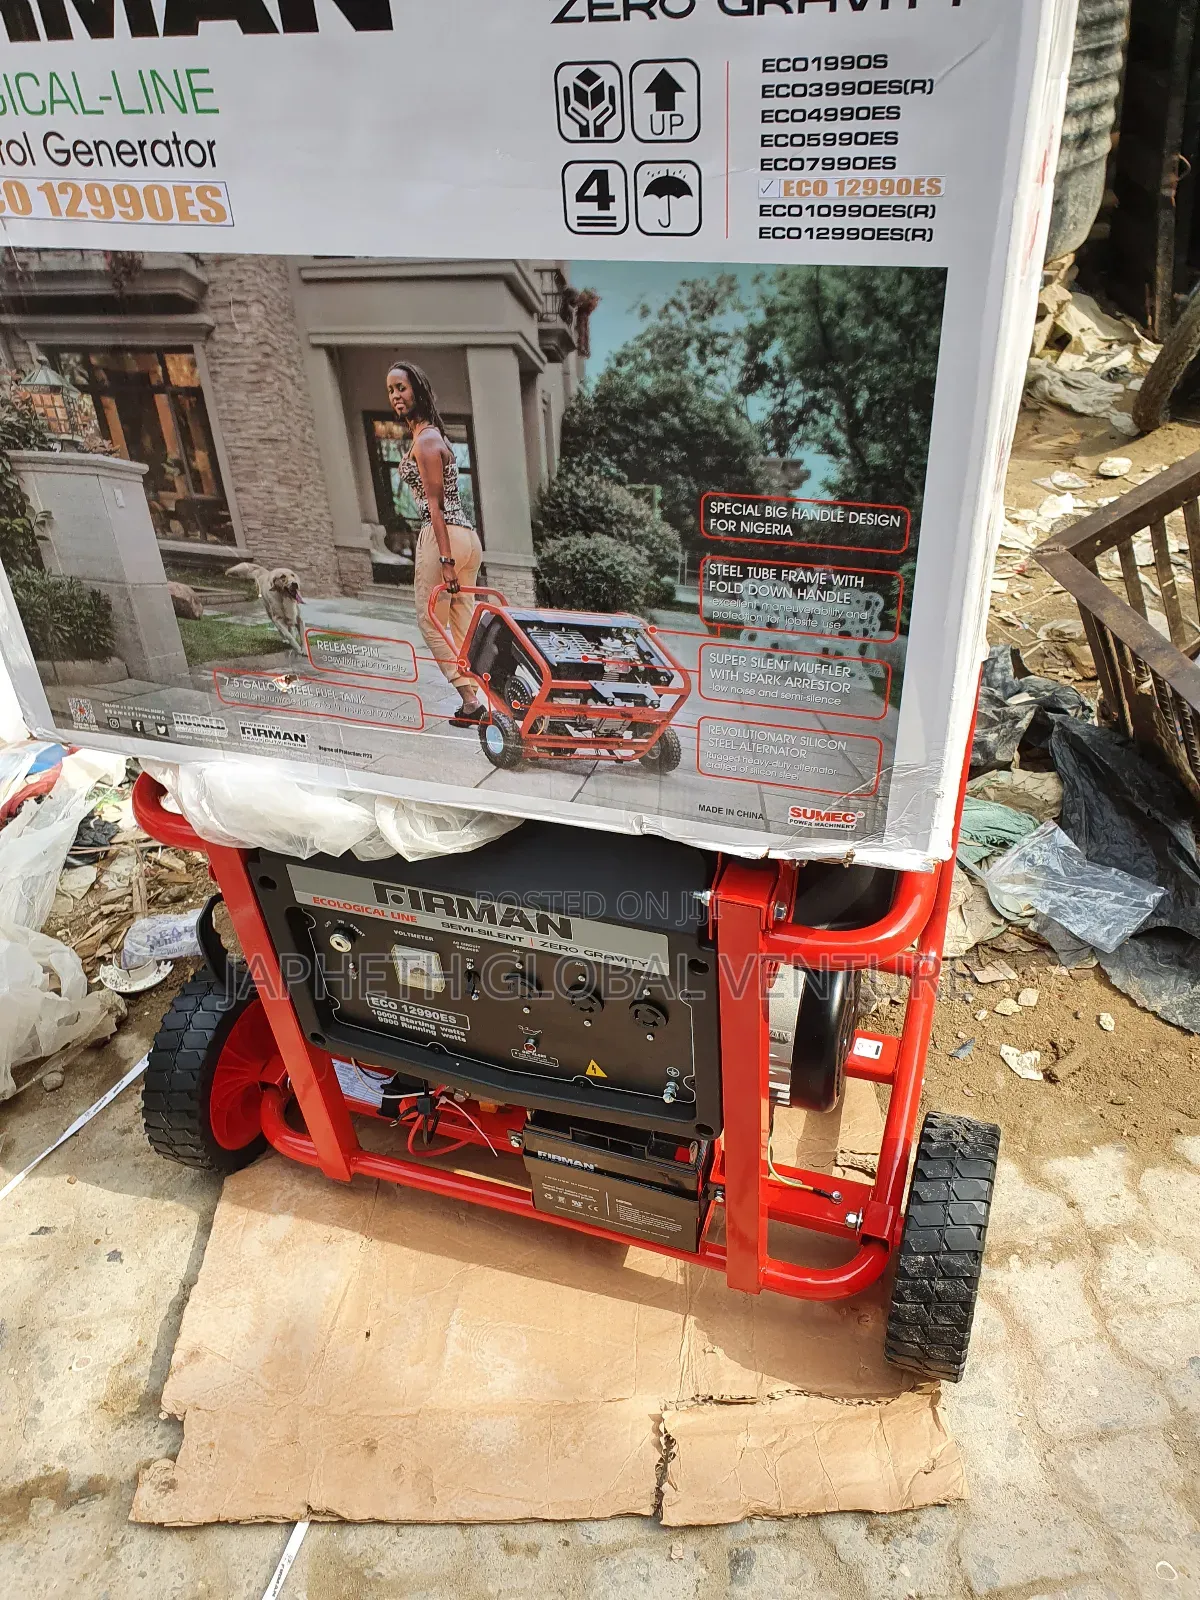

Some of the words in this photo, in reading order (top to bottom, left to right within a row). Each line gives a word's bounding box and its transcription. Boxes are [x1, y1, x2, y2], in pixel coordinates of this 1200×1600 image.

[762, 54, 888, 73] ECO1990S
[761, 79, 934, 100] ECO3990ES(R)
[650, 113, 685, 136] UP
[761, 106, 900, 123] ECO4990ES
[43, 131, 217, 168] Generator
[761, 131, 898, 148] ECO5990ES
[761, 156, 896, 172] ECO7990ES
[783, 180, 828, 198] ECO
[835, 177, 941, 197] 12990ES
[37, 181, 228, 224] 12990ES
[760, 204, 936, 220] ECO10990ES(R)
[759, 227, 933, 242] ECO12990ES(R)
[710, 502, 761, 518] SPECIAL
[765, 506, 787, 519] BIG
[791, 508, 845, 523] HANDLE
[848, 511, 901, 527] DESIGN
[710, 519, 737, 532] FOR
[740, 522, 793, 537] NIGERIA
[710, 564, 743, 578] STEEL
[747, 567, 776, 581] TUBE
[781, 570, 827, 586] FRAME
[831, 574, 865, 588] WITH
[710, 581, 744, 595] FOLD
[749, 584, 793, 600] DOWN
[797, 588, 851, 605] HANDLE
[712, 609, 764, 623] protection
[767, 614, 780, 624] for
[822, 620, 840, 630] use
[846, 609, 868, 620] and
[317, 640, 360, 656] RELEASE
[709, 653, 747, 667] SUPER
[750, 656, 790, 672] SILENT
[793, 661, 851, 678] MUFFLER
[710, 669, 739, 681] WITH
[743, 672, 781, 686] SPARK
[785, 676, 851, 694] ARRESTOR
[340, 691, 366, 704] TANK
[731, 685, 756, 696] noise
[758, 687, 777, 699] and
[780, 690, 841, 706] semi-silence
[240, 726, 306, 743] FIRMAN
[708, 724, 797, 746] REVOLUTIONARY
[800, 735, 847, 751] SILICON
[708, 737, 739, 750] STEEL
[739, 742, 807, 759] ALTERNATOR
[795, 761, 837, 776] alternator
[698, 803, 724, 816] MADE
[725, 806, 734, 816] IN
[736, 808, 764, 821] CHINA
[790, 807, 856, 823] SUMEC
[789, 818, 812, 827] POWER
[814, 821, 856, 830] MACHINERY
[312, 896, 388, 918] ECOLOGICAL
[390, 911, 418, 924] LINE
[372, 882, 573, 940] FIRMAN
[393, 930, 434, 942] VOLTMETER
[441, 921, 524, 943] SEMI-SILENT
[539, 940, 579, 955] ZERO
[583, 949, 649, 969] GRAVITY
[370, 996, 397, 1010] ECO
[401, 1003, 457, 1025] 12990ES
[372, 1009, 397, 1020] 10000
[400, 1015, 436, 1031] Starting
[440, 1026, 465, 1038] watts
[401, 1021, 437, 1037] Running
[441, 1031, 467, 1043] watts
[537, 1150, 595, 1170] FIRMAN
